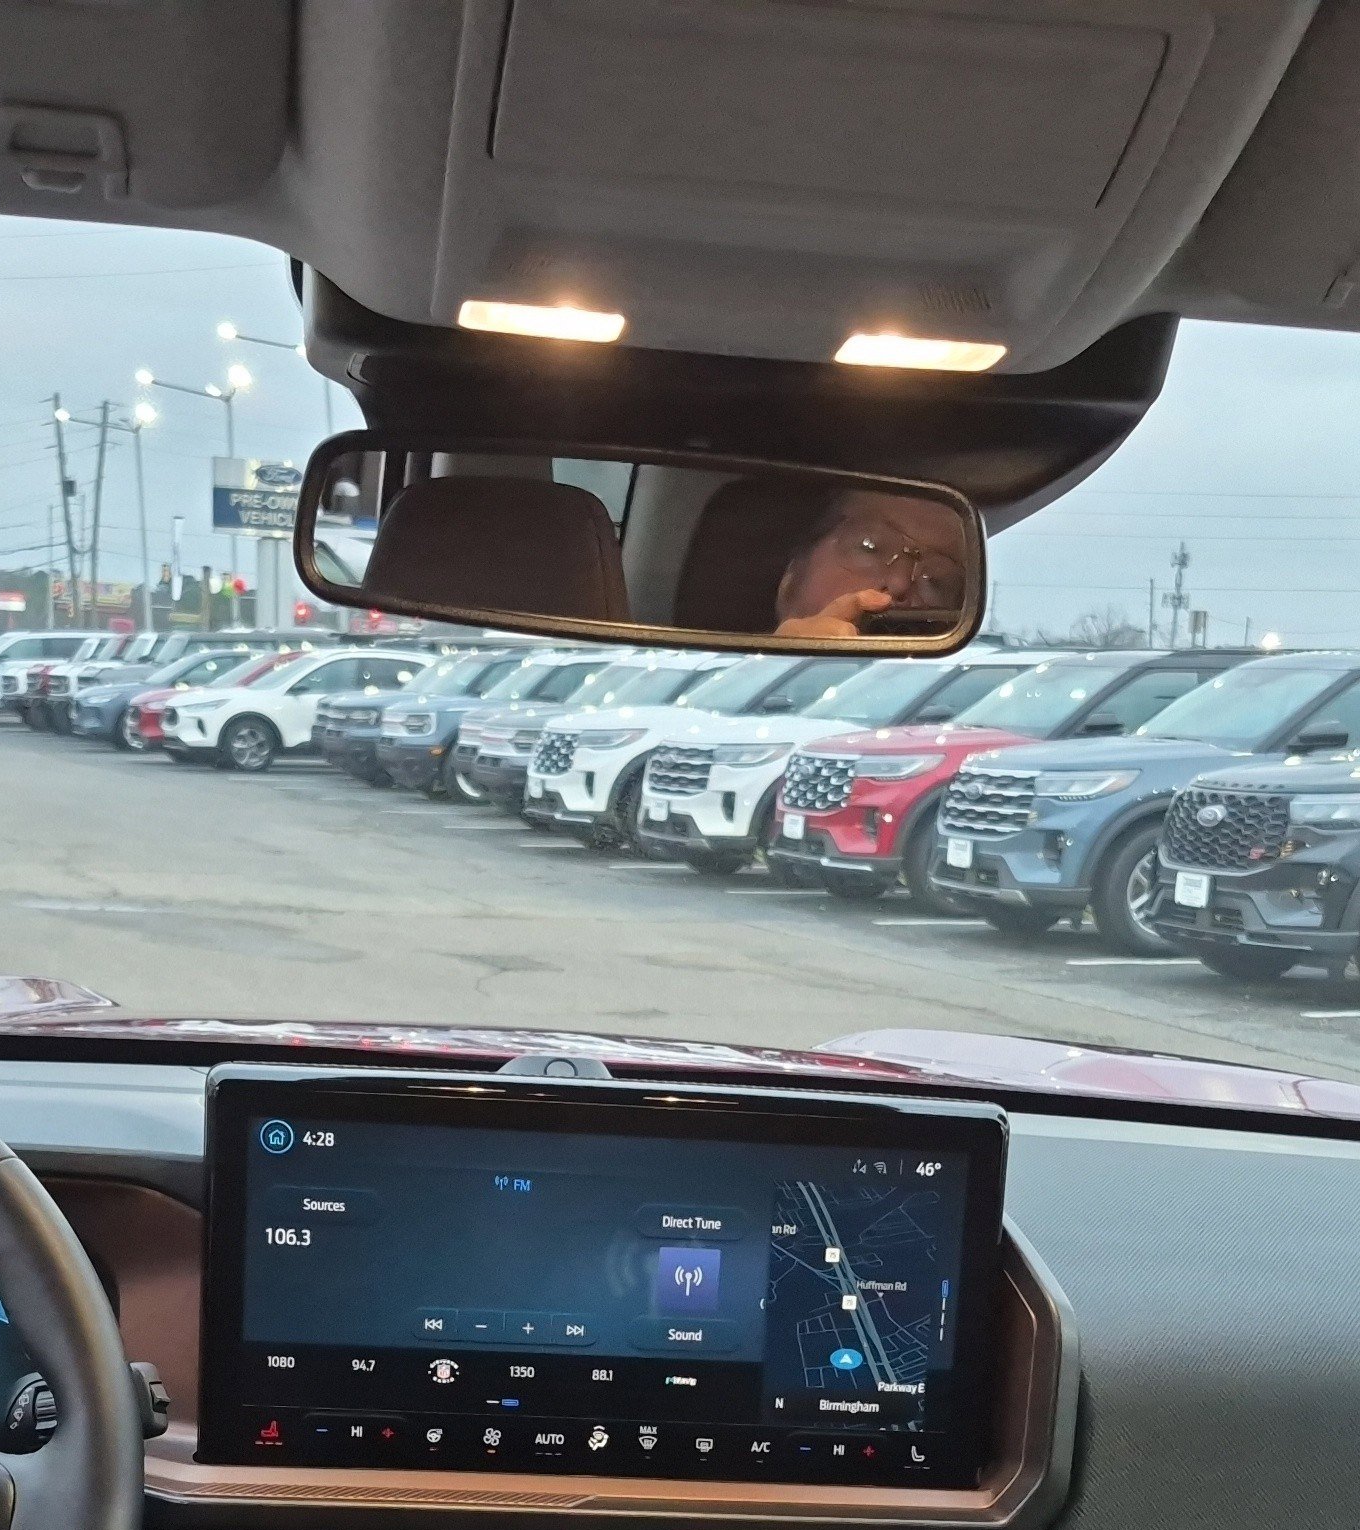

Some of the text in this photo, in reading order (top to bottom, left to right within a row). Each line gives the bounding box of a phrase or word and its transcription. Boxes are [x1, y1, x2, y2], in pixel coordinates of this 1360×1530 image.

[230, 492, 298, 510] PRE-OW
[239, 510, 295, 527] VEHICL
[302, 1130, 335, 1148] 4:28
[513, 1179, 532, 1192] FM
[302, 1198, 346, 1213] Sources
[662, 1215, 722, 1231] Direct Tune
[783, 1224, 797, 1235] Rd
[265, 1227, 311, 1247] 106.3
[856, 1280, 907, 1292] Huffman Rd
[668, 1328, 703, 1342] Sound
[266, 1355, 295, 1369] 1080
[351, 1358, 376, 1373] 94.7
[509, 1365, 535, 1379] 1350
[591, 1368, 614, 1382] 88.1
[877, 1381, 925, 1395] Parkway E
[775, 1397, 784, 1409] N
[819, 1399, 880, 1413] Birmingham
[351, 1426, 363, 1439] HI
[639, 1425, 657, 1434] MAX
[535, 1433, 565, 1446] AUTO
[750, 1441, 771, 1453] A/C
[833, 1444, 845, 1456] HI
